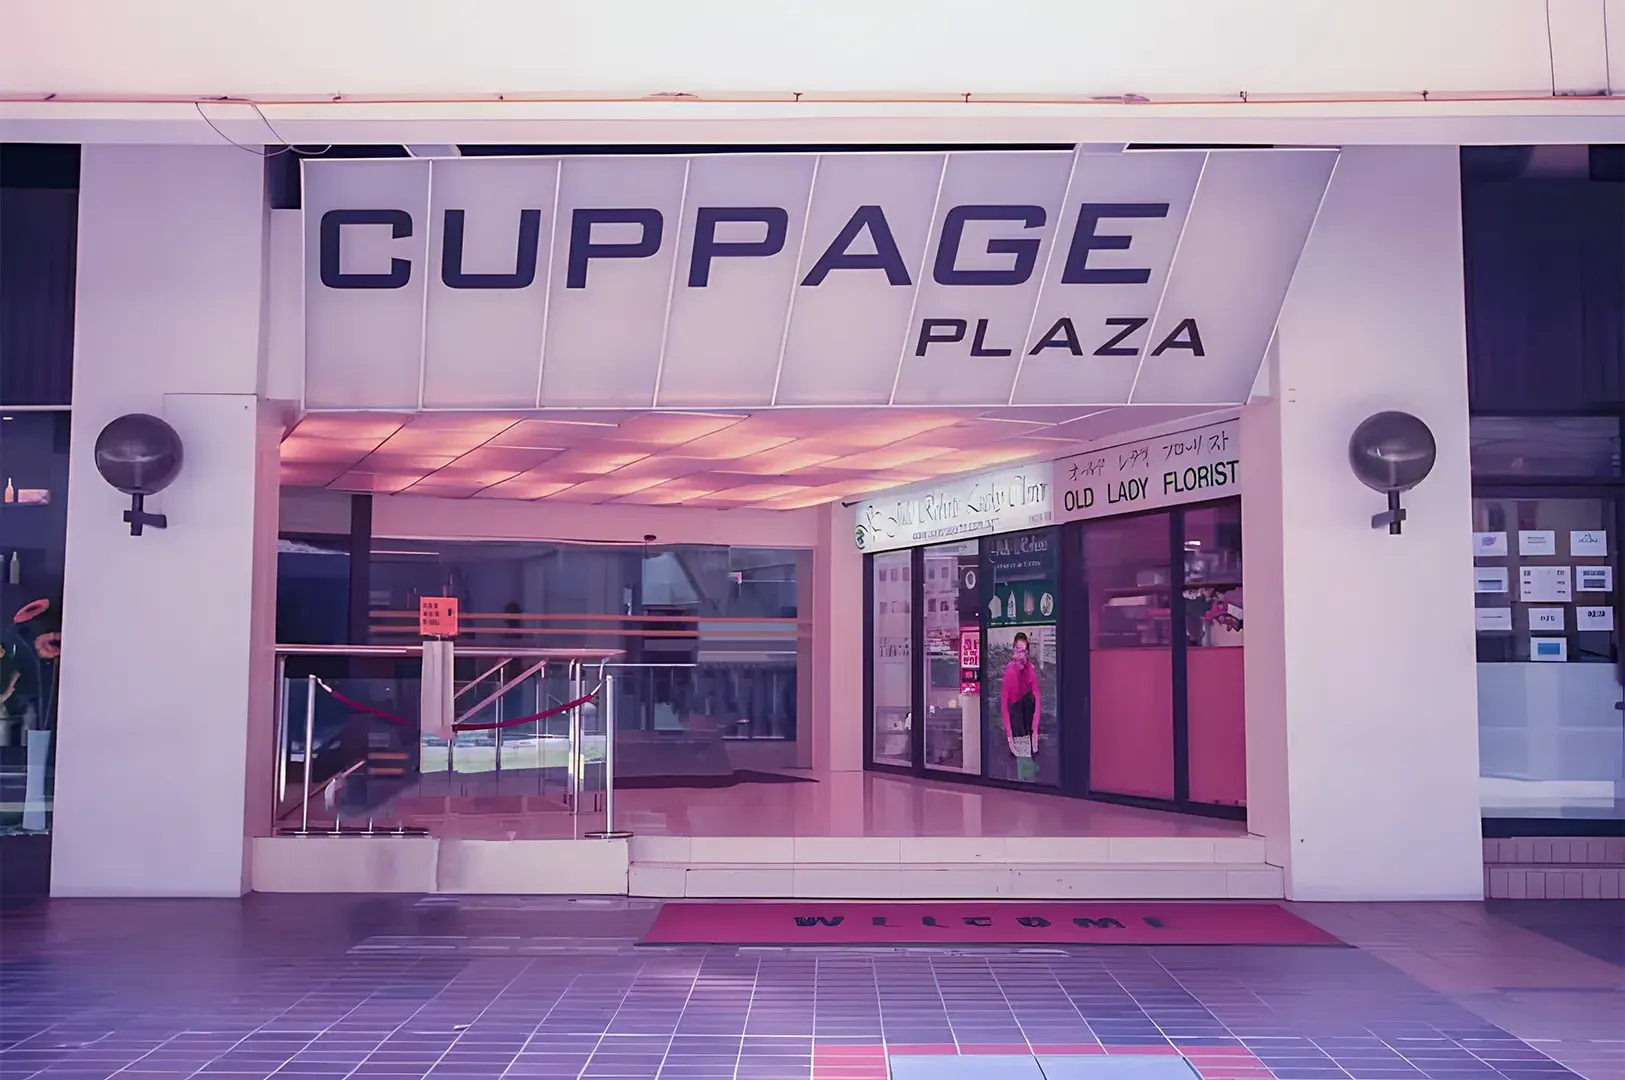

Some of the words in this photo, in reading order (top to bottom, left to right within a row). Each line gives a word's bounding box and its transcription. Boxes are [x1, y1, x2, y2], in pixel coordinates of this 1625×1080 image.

[320, 203, 1170, 289] CUPPAGE
[915, 317, 1206, 357] PLAZA
[1064, 487, 1094, 511] OLD
[1107, 477, 1148, 504] LADY
[1163, 460, 1239, 495] FLORIST
